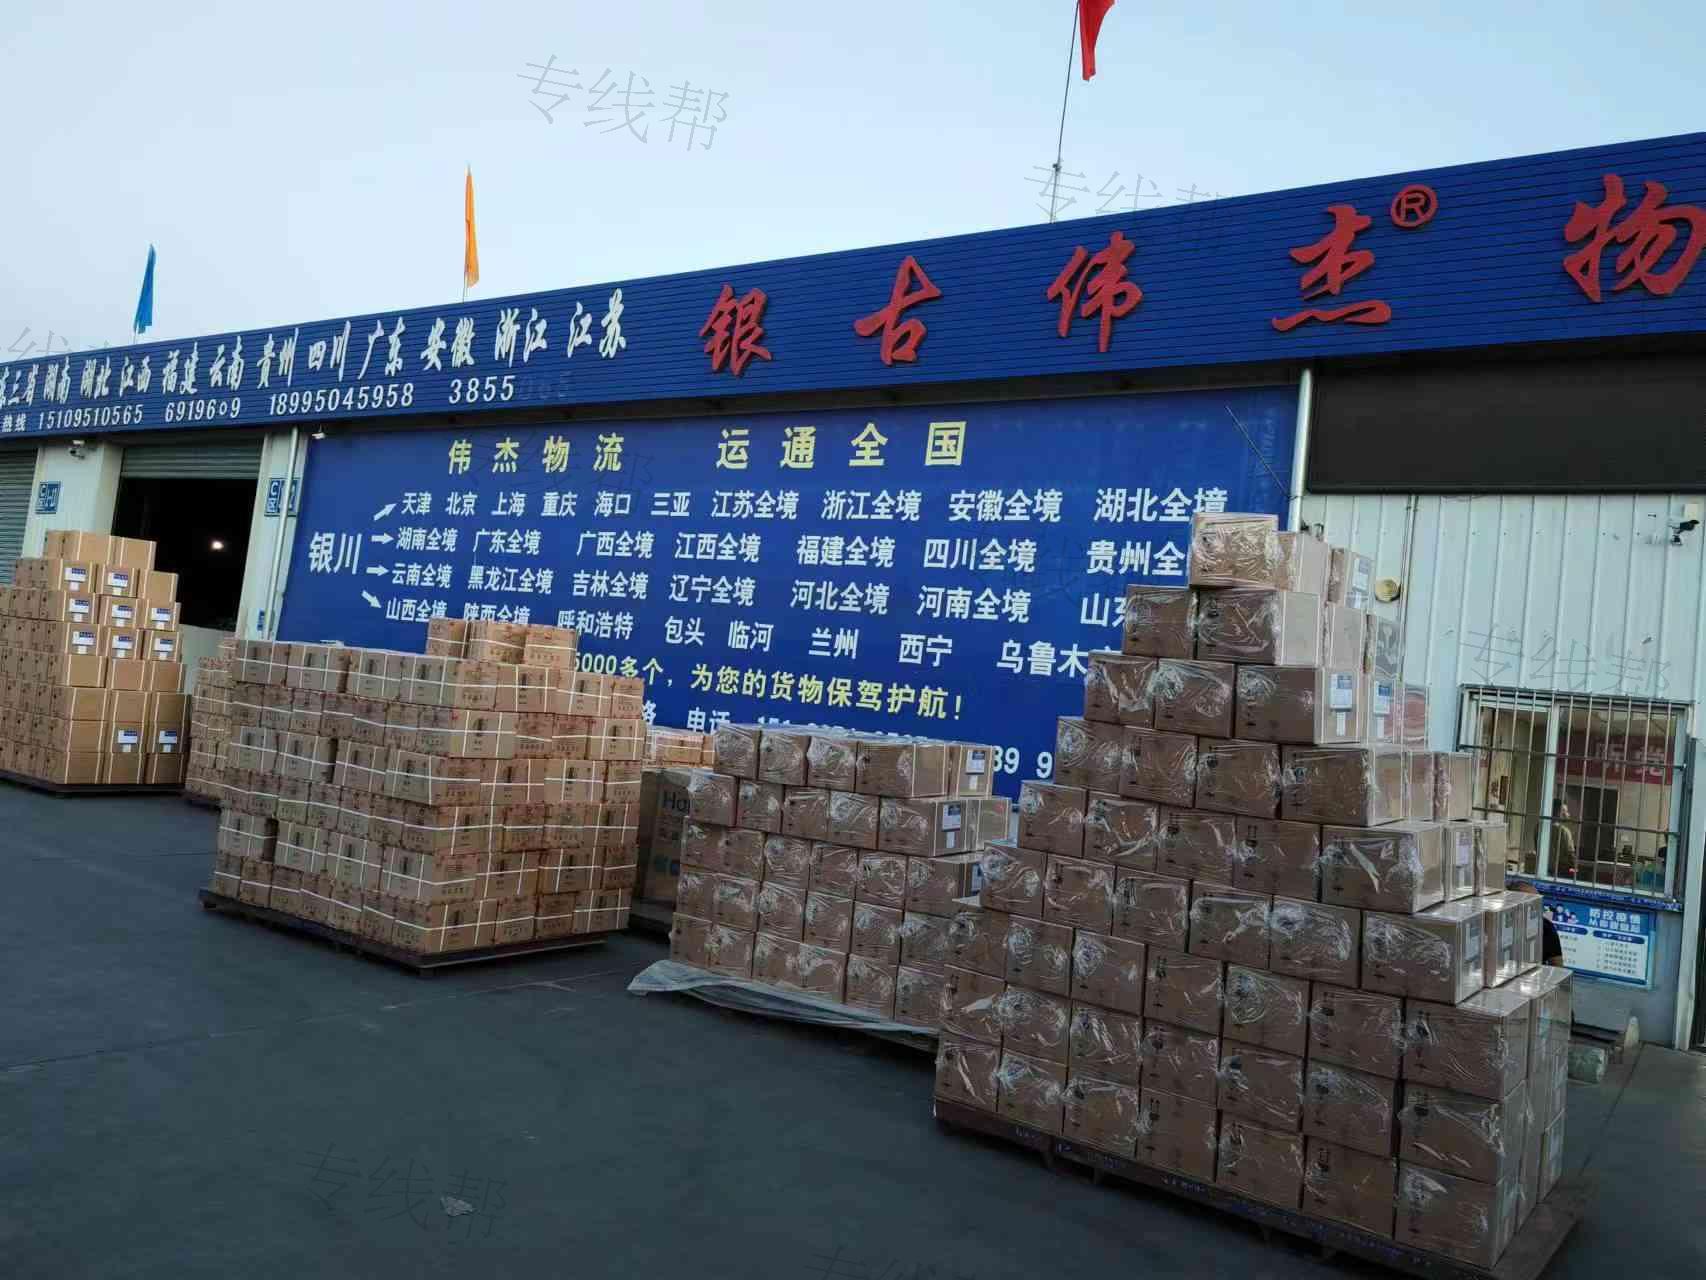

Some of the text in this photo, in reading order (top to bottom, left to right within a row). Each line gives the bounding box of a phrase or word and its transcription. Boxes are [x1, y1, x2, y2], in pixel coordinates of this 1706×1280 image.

[162, 341, 199, 395] 福建
[209, 335, 244, 391] 云南
[256, 327, 299, 389] 贵州
[308, 320, 351, 382] 四川
[358, 317, 406, 380] 广东
[420, 317, 475, 372] 安徽
[567, 288, 627, 359] 江苏
[38, 404, 144, 431] 15109510565
[269, 382, 414, 416] 18995045958
[401, 487, 1229, 523] 天津 北京 上海 重庆 海口 三亚 江苏全境 浙江全境 安徽全境 湖北全境
[308, 531, 363, 576] 银川
[396, 526, 459, 553] 湖南全境
[472, 527, 543, 557] 广东全境
[575, 530, 655, 560] 广西全境
[674, 530, 761, 563] 江西全境
[796, 534, 897, 568] 福建全境
[923, 538, 1037, 573] 四川全境
[391, 562, 452, 589] 云南全境
[467, 564, 554, 596] 黑龙江全境
[572, 568, 649, 600] 吉林全境
[668, 573, 756, 607] 辽宁全境
[791, 579, 890, 616] 河北全境
[916, 584, 1032, 624] 河南全境
[385, 597, 448, 623] 山西全境
[556, 608, 634, 641] 呼和浩特
[663, 613, 705, 647] 包头
[728, 619, 773, 652] 临河
[809, 626, 860, 661] 兰州
[898, 632, 953, 668] 西宁
[996, 639, 1122, 678] 乌鲁木
